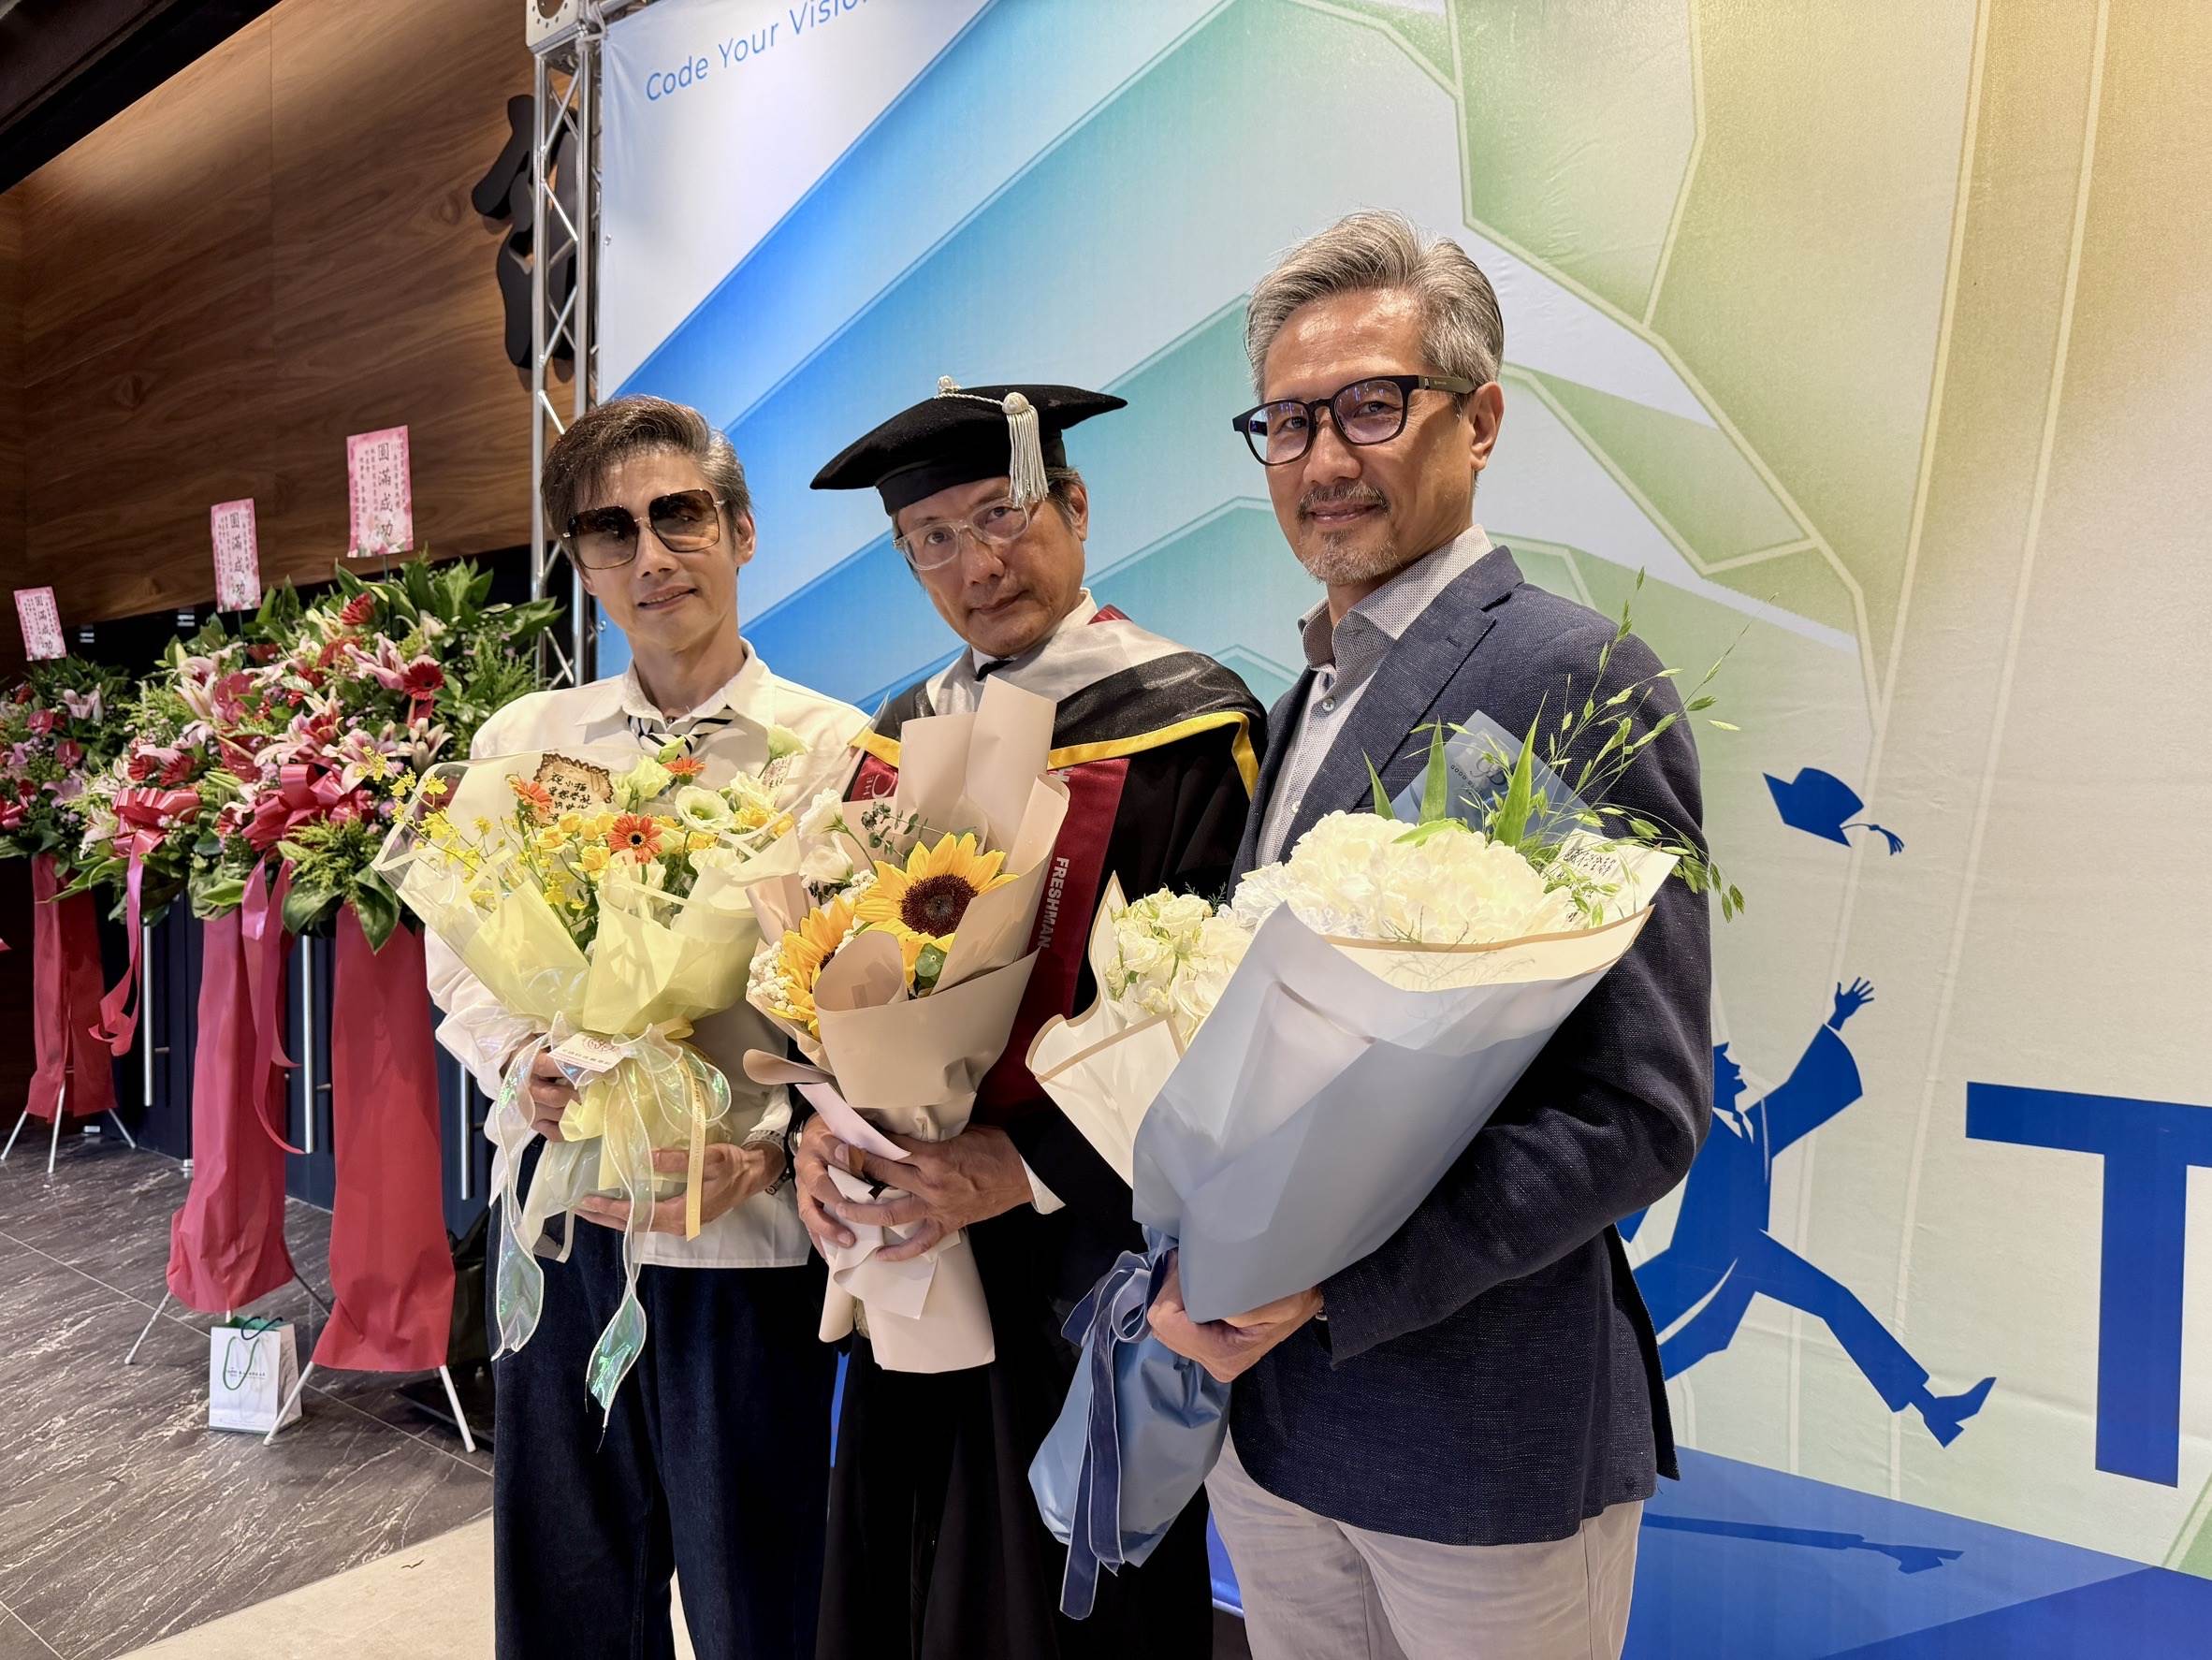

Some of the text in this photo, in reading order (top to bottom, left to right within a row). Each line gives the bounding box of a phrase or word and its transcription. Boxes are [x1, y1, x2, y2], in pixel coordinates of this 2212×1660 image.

[646, 56, 709, 101] Code
[718, 22, 779, 68] Your
[378, 443, 393, 537] 圓滿成功
[229, 512, 245, 595] 圓滿成功
[1037, 856, 1070, 948] FRESHMAN
